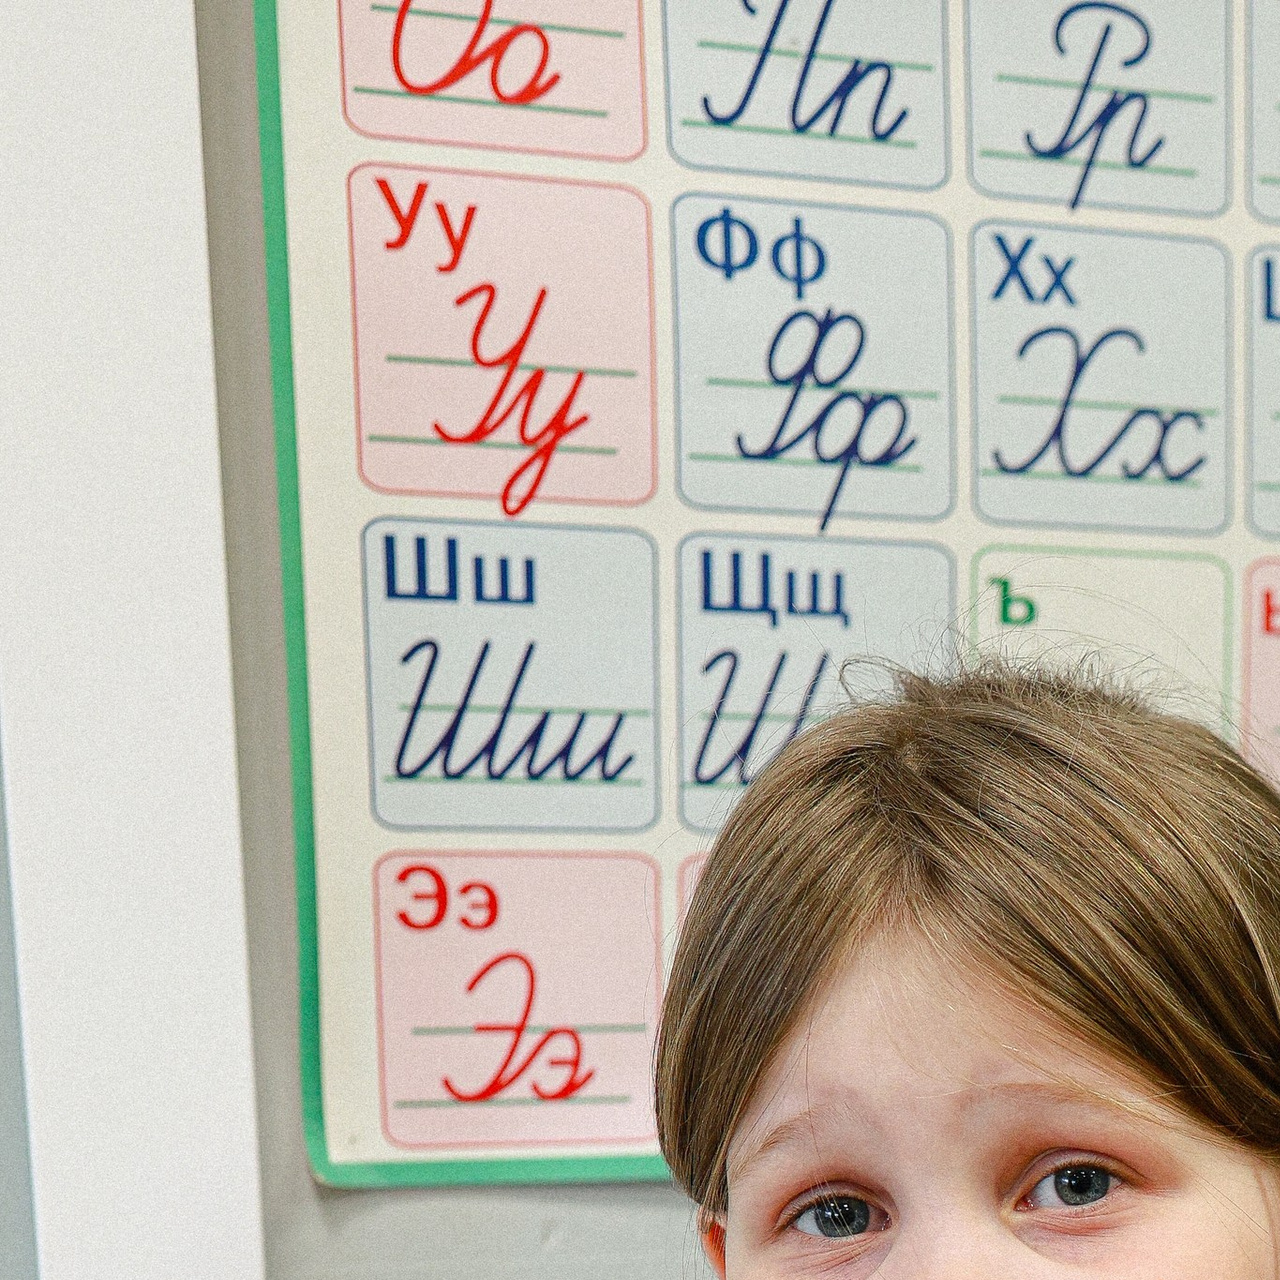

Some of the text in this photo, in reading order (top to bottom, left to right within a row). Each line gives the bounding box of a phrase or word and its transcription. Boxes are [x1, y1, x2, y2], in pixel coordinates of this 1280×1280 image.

[1024, 1, 1165, 209] Рр
[375, 178, 477, 273] Уу
[696, 207, 825, 300] Фф
[991, 234, 1076, 306] Хх
[433, 284, 590, 517] Уу
[736, 308, 916, 532] Фф
[991, 325, 1207, 481] Хх
[384, 534, 536, 605] Шш
[700, 551, 850, 627] Щщ
[394, 640, 637, 782] Шш
[397, 864, 499, 932] Ээ
[442, 951, 594, 1102] Ээ
